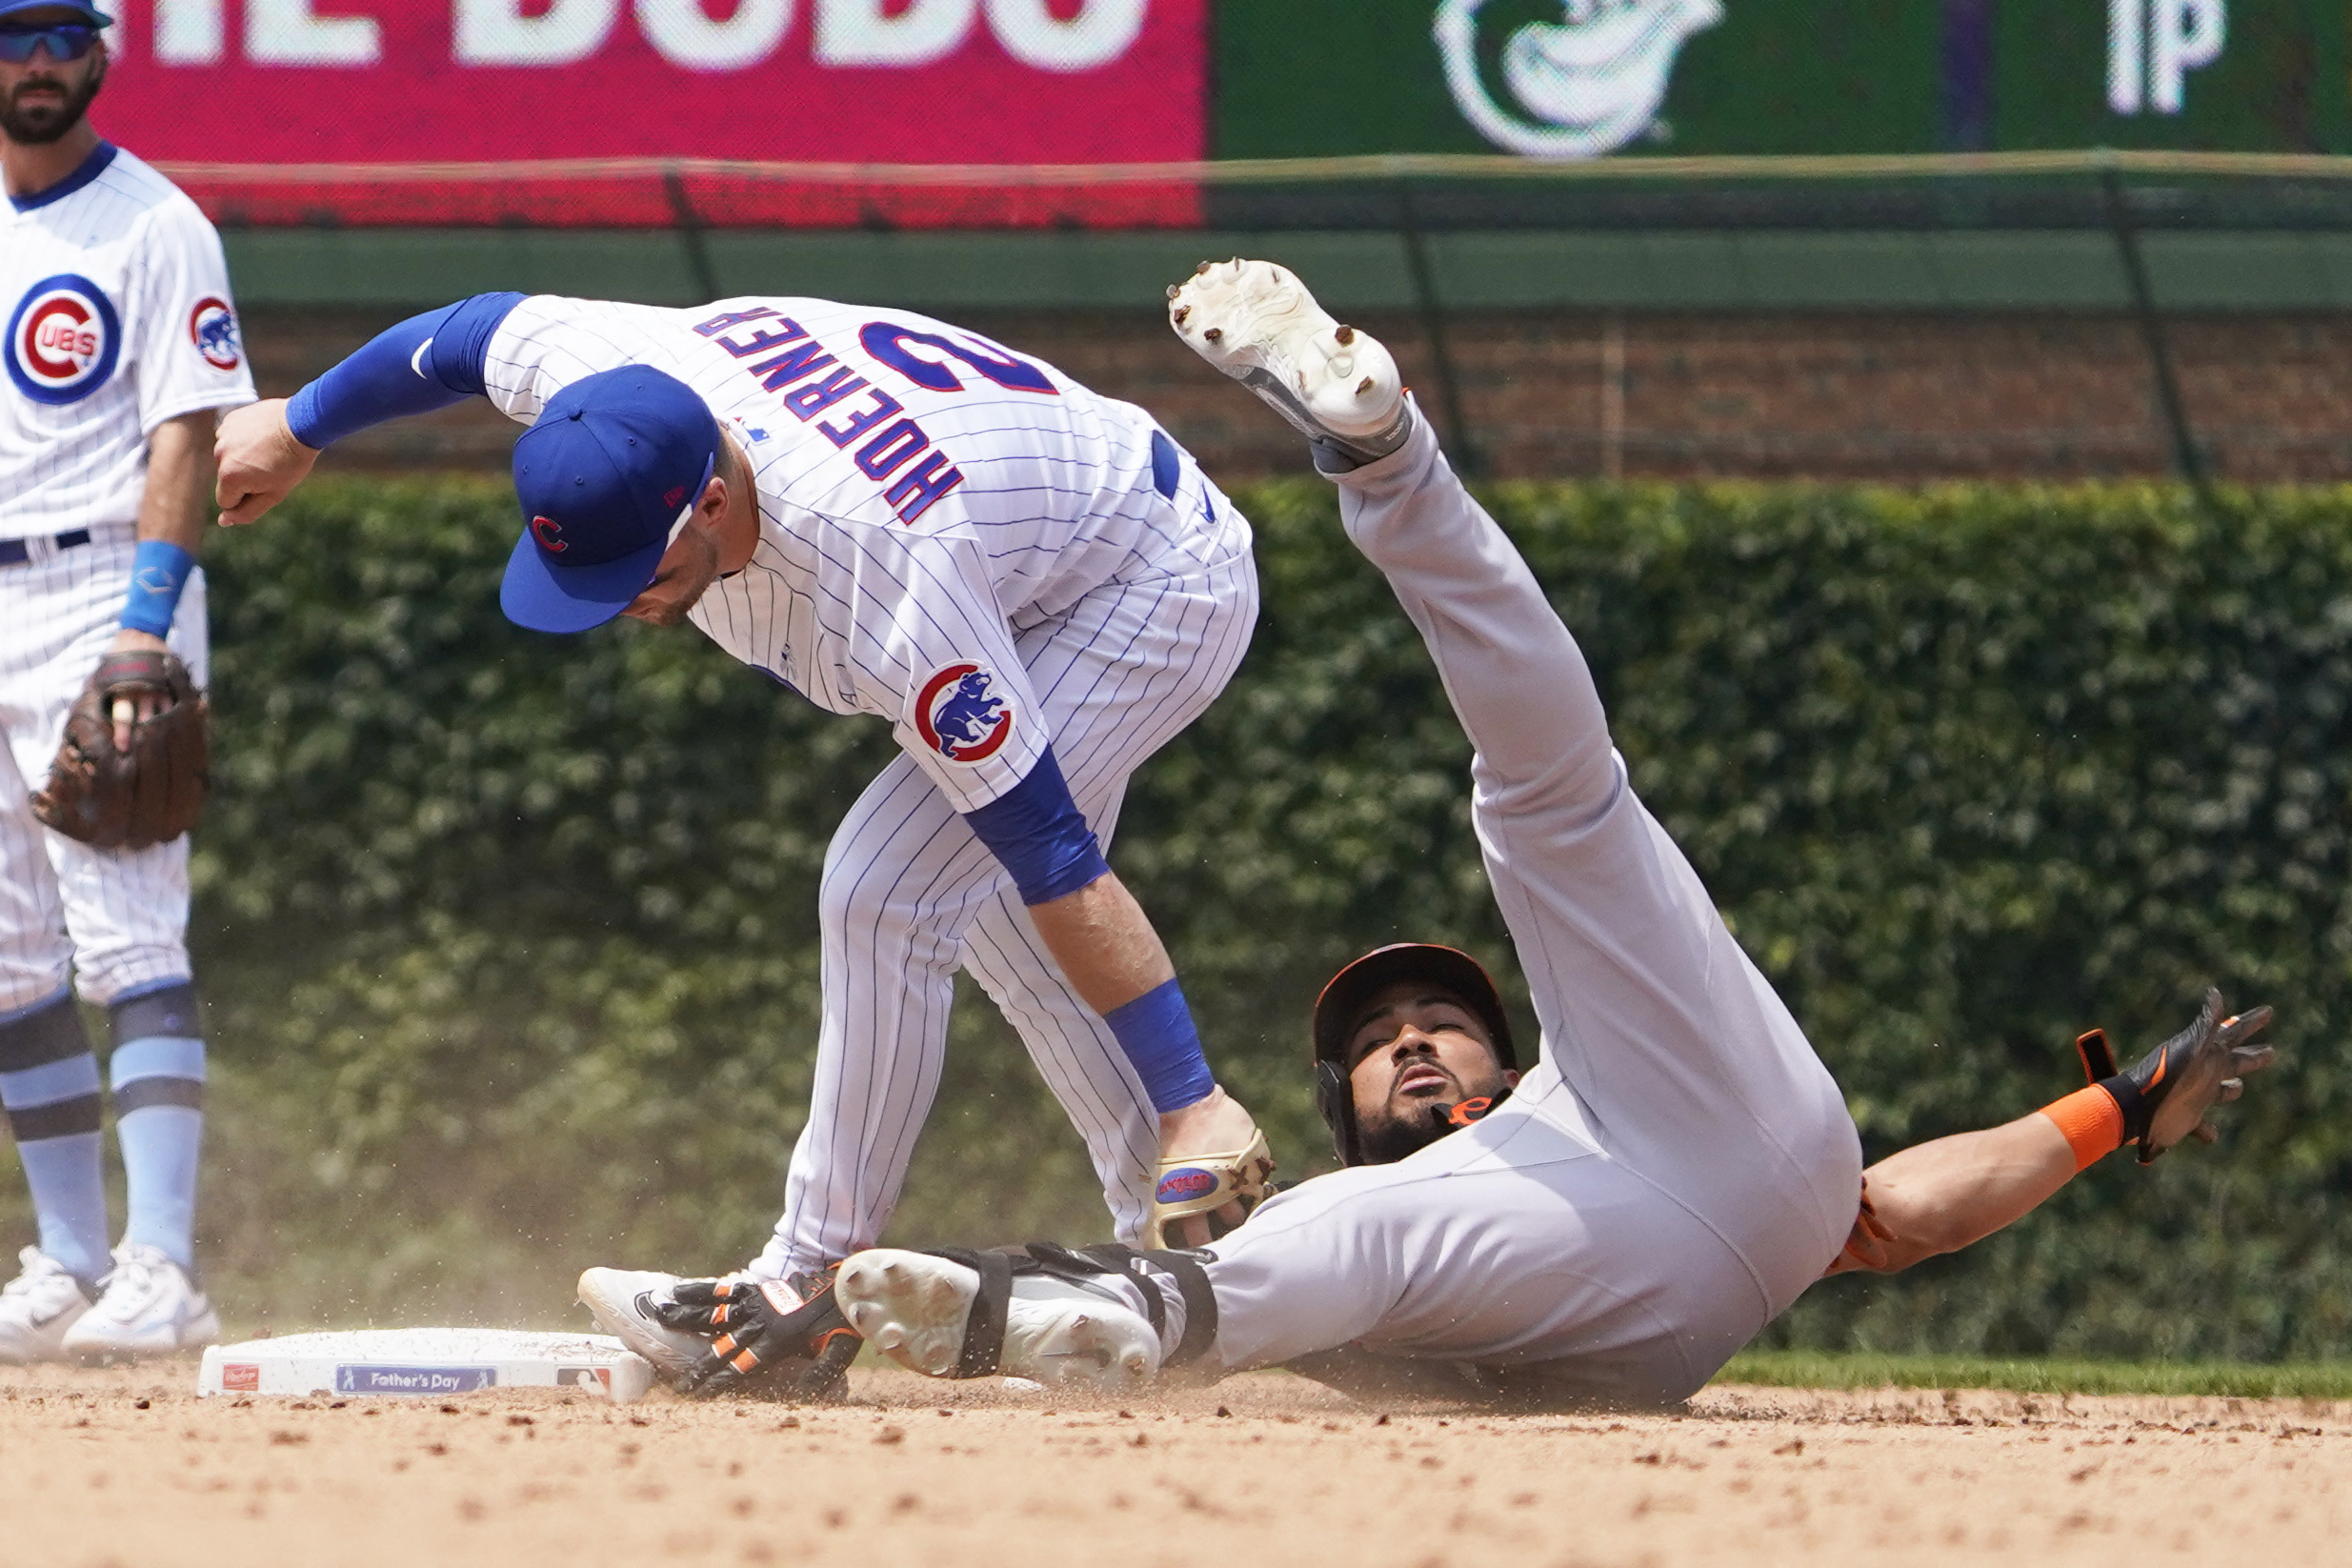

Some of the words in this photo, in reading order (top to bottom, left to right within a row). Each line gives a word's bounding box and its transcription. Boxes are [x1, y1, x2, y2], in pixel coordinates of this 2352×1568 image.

[858, 321, 1060, 395] 2
[693, 307, 964, 525] HOERNER
[533, 515, 569, 553] C
[371, 1372, 429, 1388] Father's
[431, 1373, 460, 1391] Day
